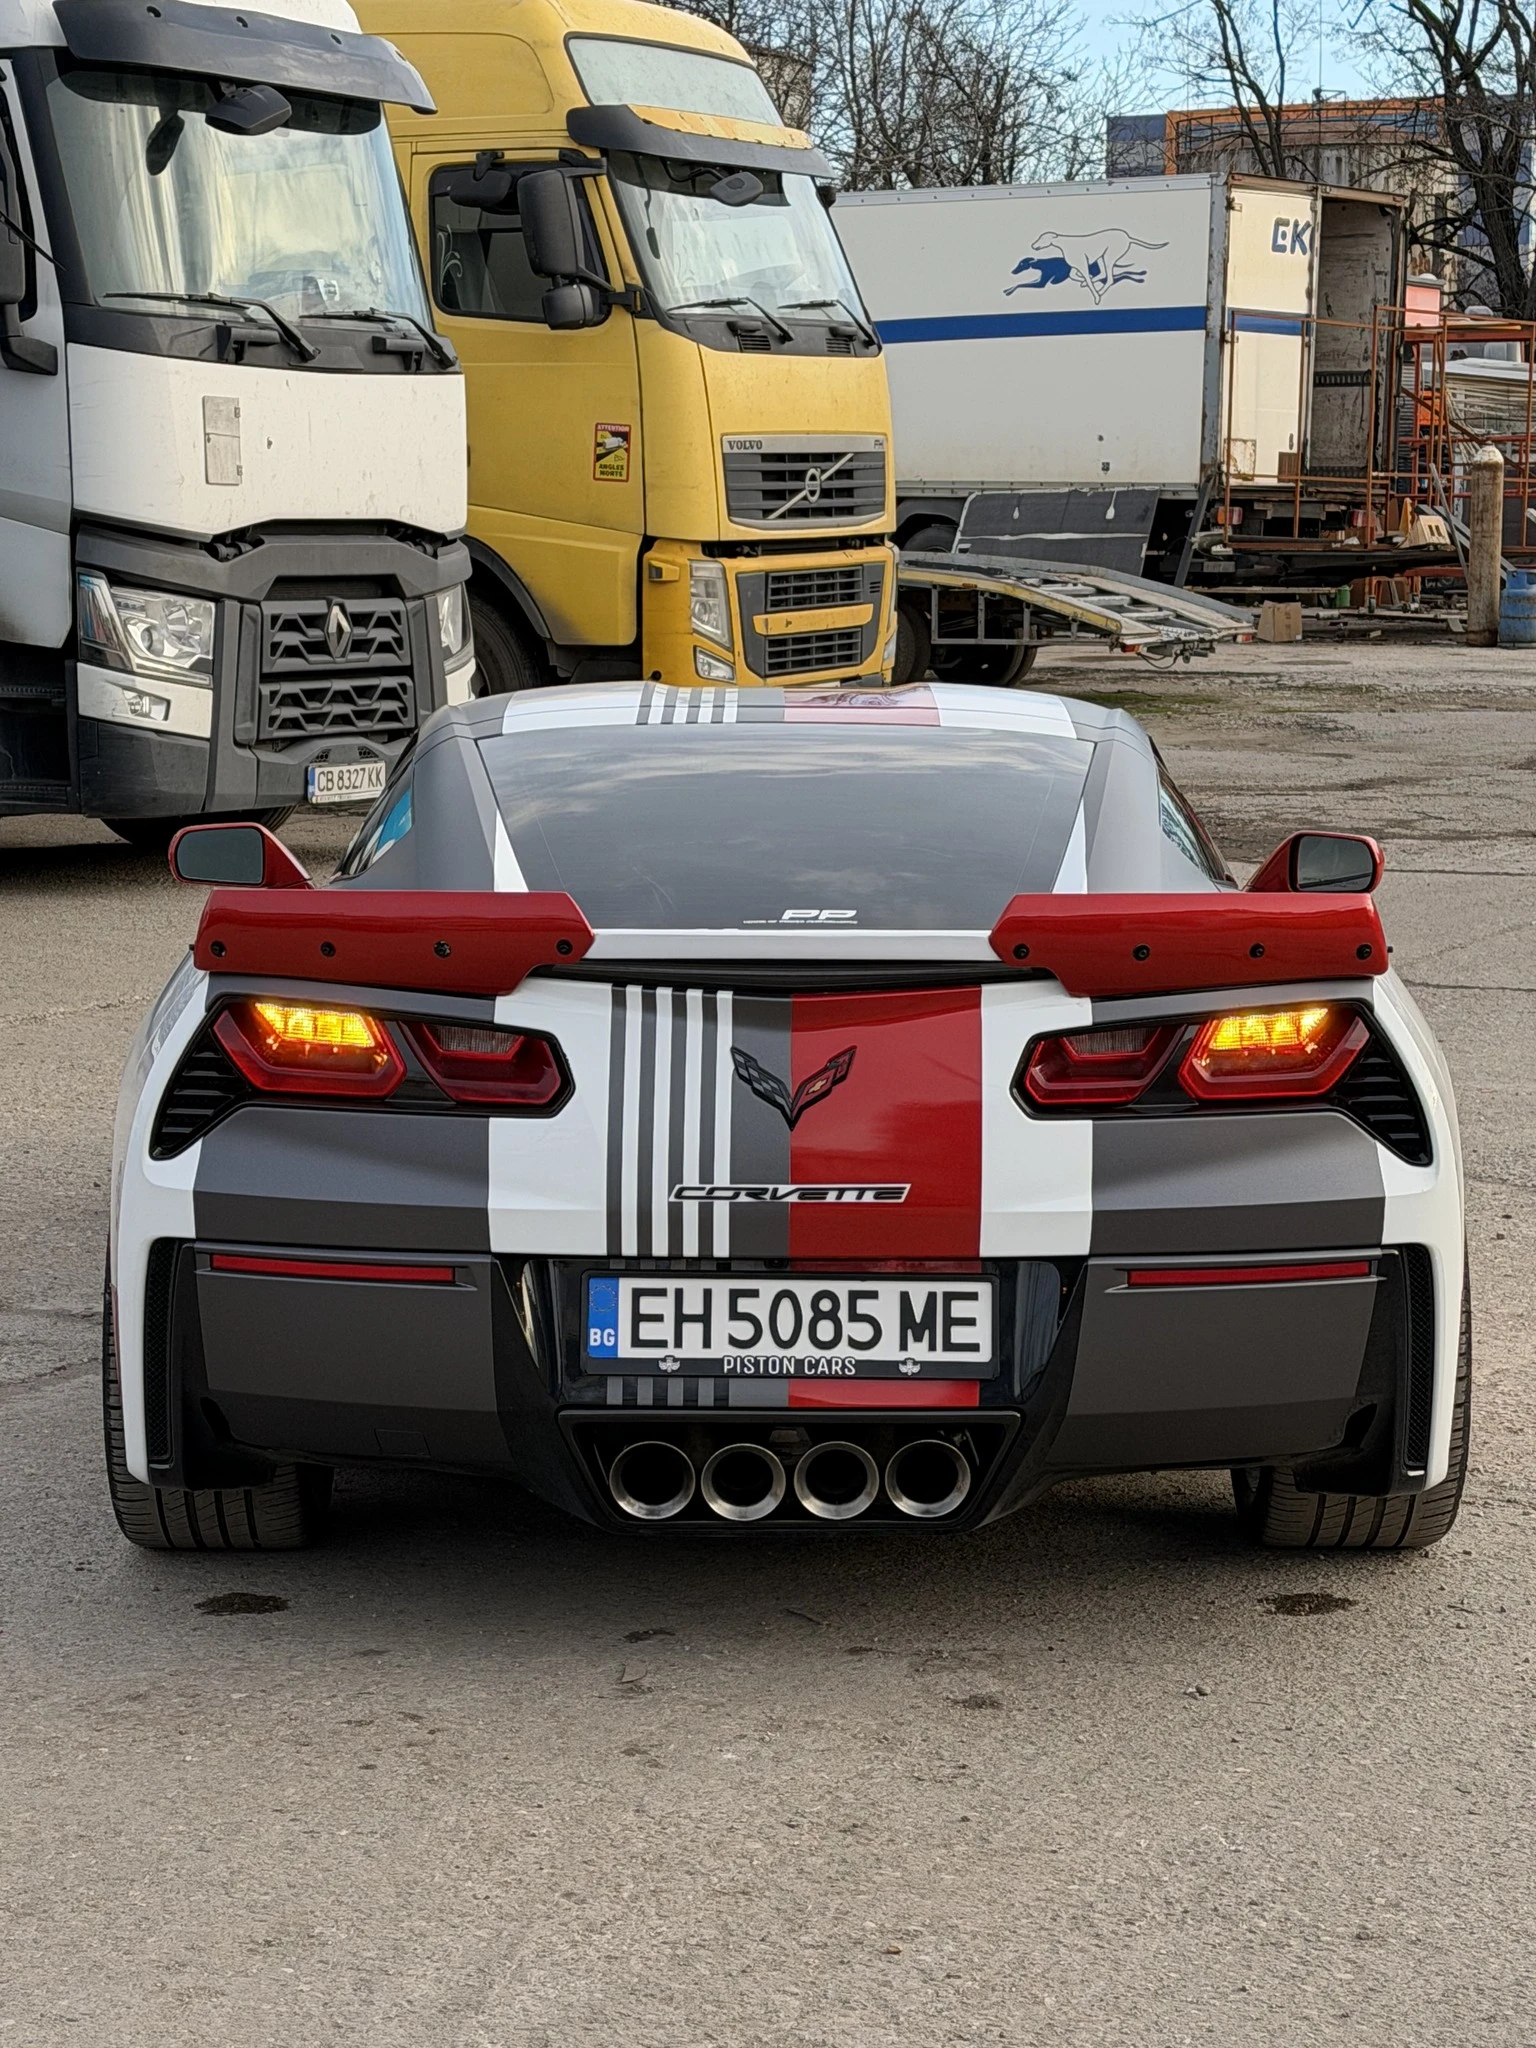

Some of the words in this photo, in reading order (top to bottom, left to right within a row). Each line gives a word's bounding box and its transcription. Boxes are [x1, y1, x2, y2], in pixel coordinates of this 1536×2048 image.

[1271, 216, 1315, 255] EK
[597, 424, 630, 432] ATTENTION
[727, 440, 763, 450] VOLVO
[317, 770, 335, 792] CB
[336, 767, 366, 791] 8327
[367, 766, 383, 789] KK
[671, 1185, 909, 1202] CORVETTE
[630, 1287, 713, 1349] EH
[728, 1288, 882, 1350] 5085
[899, 1291, 980, 1352] ME
[589, 1328, 616, 1347] BG
[723, 1356, 795, 1374] PISTON
[804, 1356, 856, 1375] CARS
